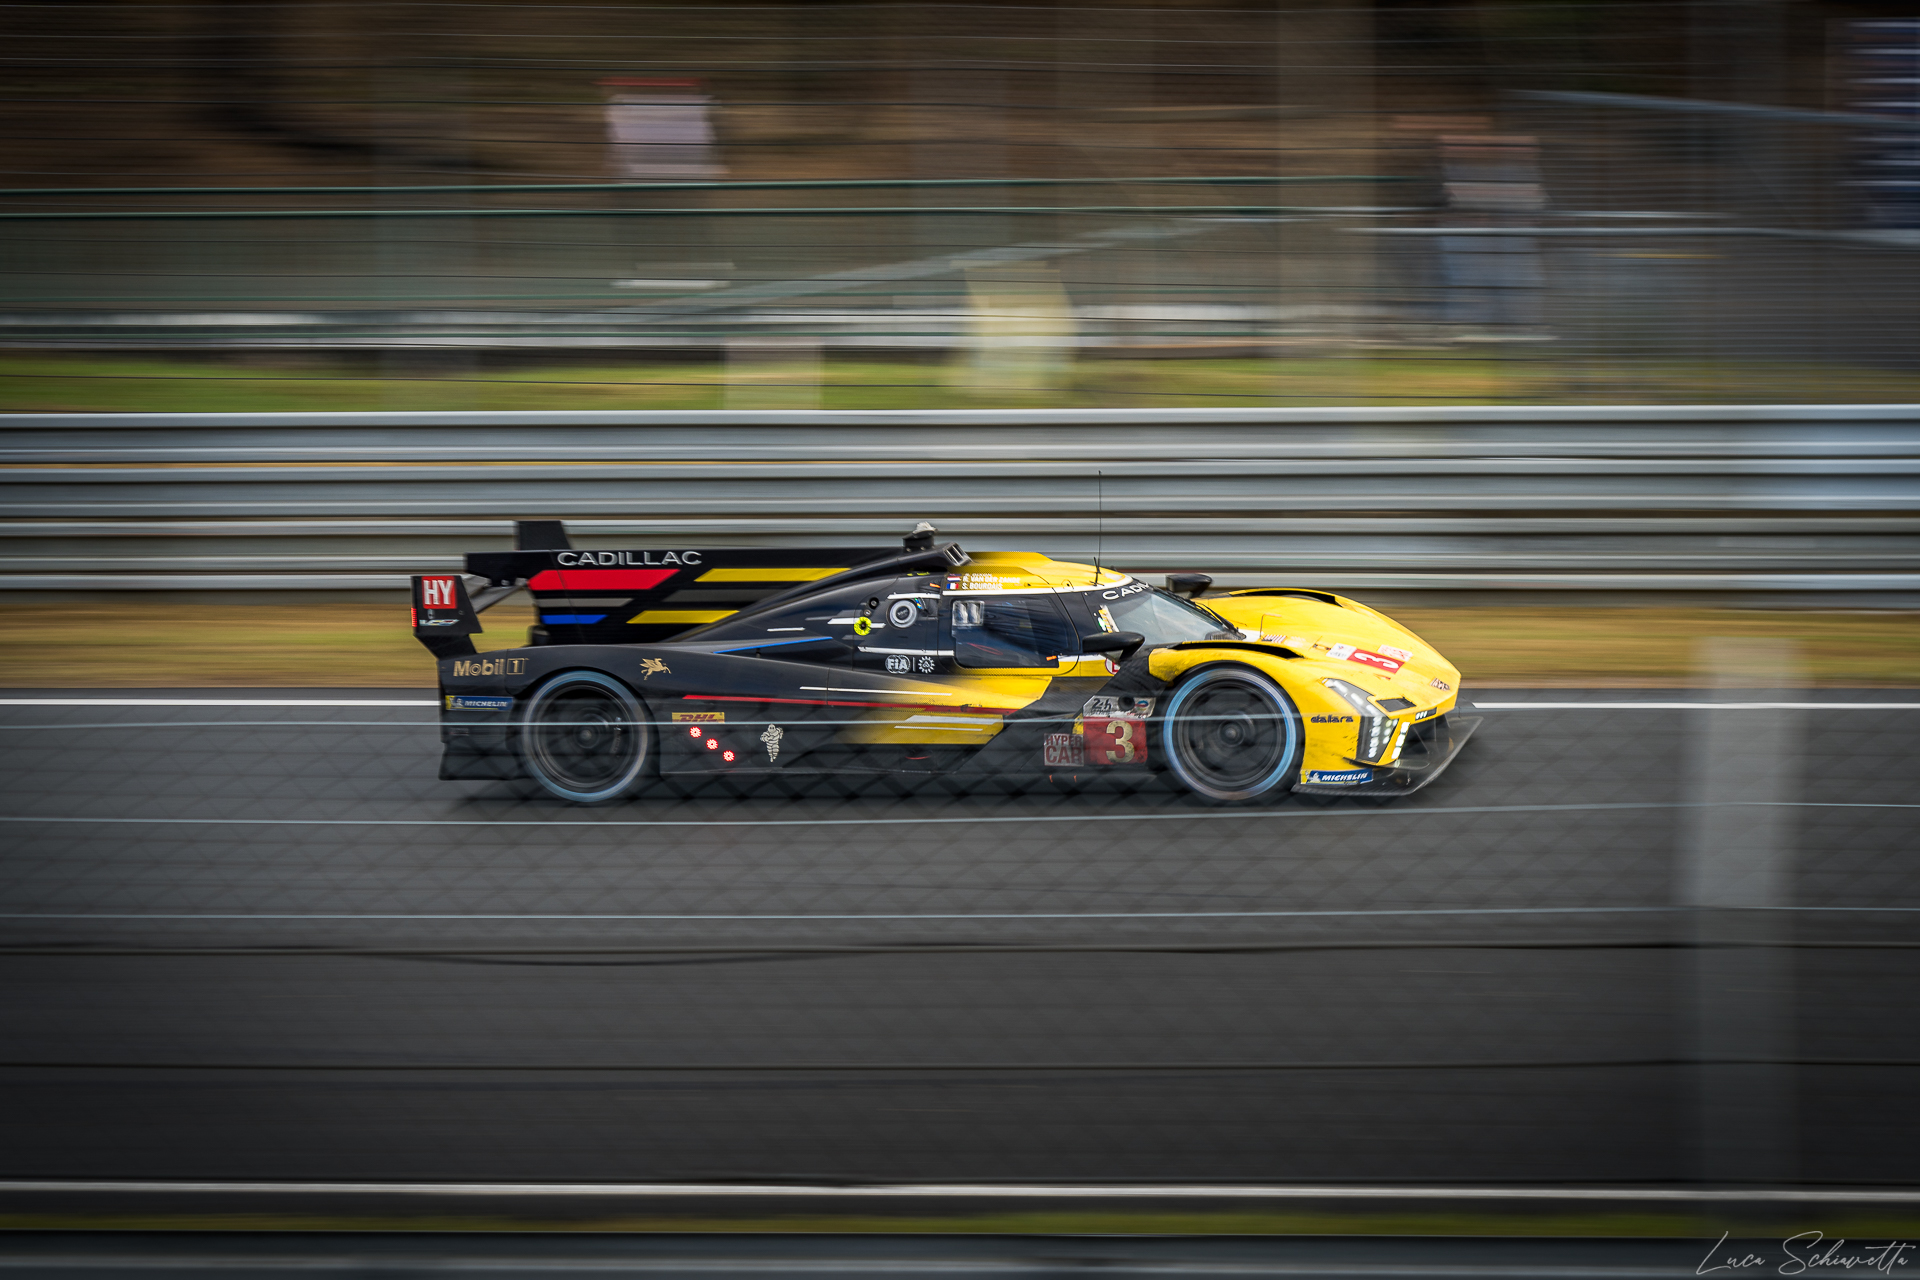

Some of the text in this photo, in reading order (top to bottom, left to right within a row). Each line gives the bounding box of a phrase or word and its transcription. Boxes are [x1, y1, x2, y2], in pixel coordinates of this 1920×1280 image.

[557, 551, 702, 566] CADILLAC
[423, 580, 453, 605] HY
[453, 659, 505, 677] Mobil
[1354, 652, 1399, 669] 3
[680, 714, 718, 722] DHL
[1046, 735, 1083, 746] HYPER
[1106, 720, 1134, 763] 3
[1046, 746, 1083, 764] CAR
[1321, 772, 1369, 781] MICHELIN
